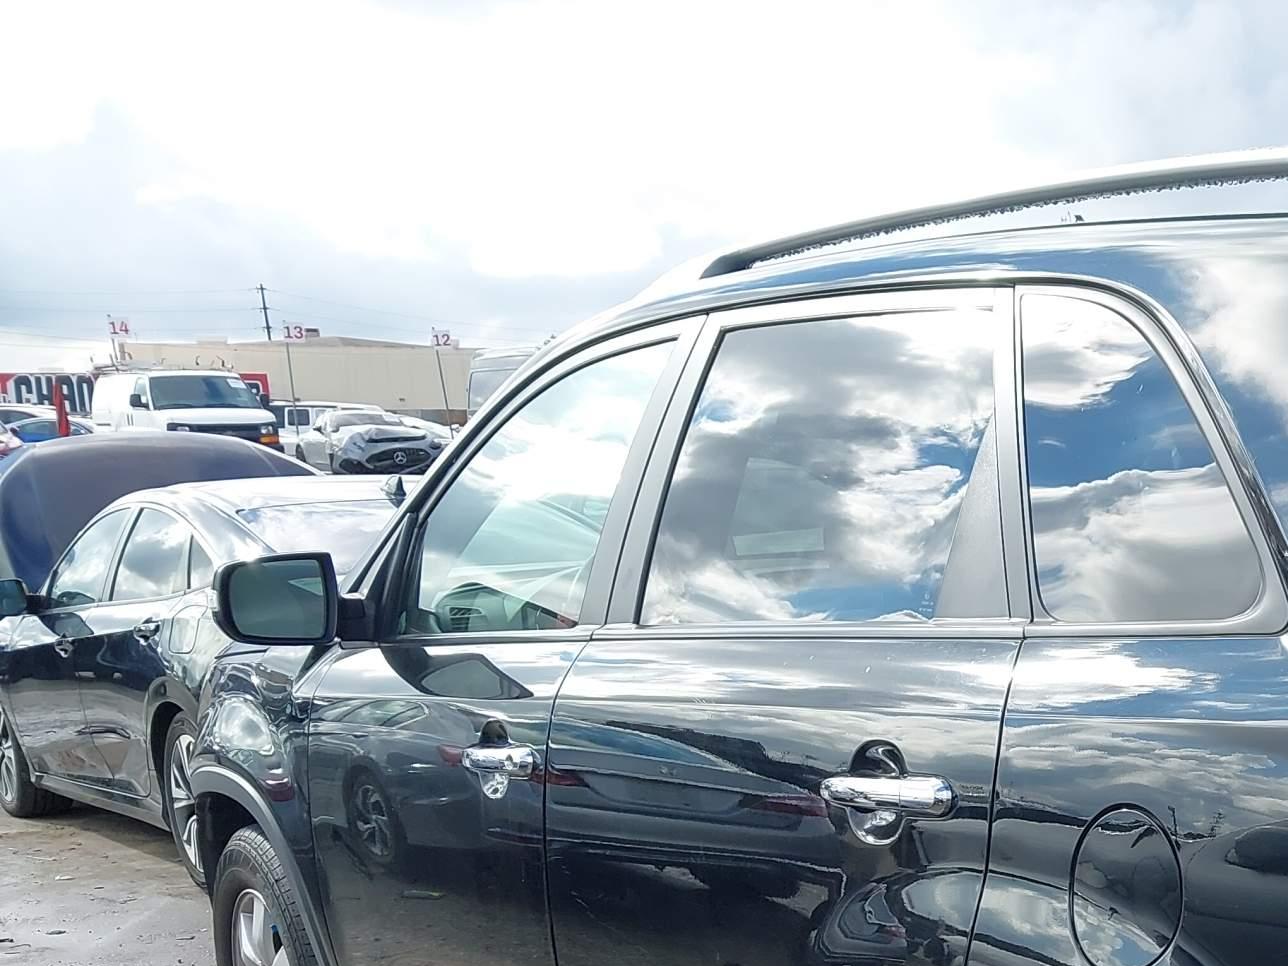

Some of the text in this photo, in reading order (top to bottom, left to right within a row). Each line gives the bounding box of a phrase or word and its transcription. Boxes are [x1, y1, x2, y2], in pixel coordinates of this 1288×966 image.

[108, 320, 129, 335] 14
[283, 325, 304, 339] 13
[432, 333, 451, 346] 12
